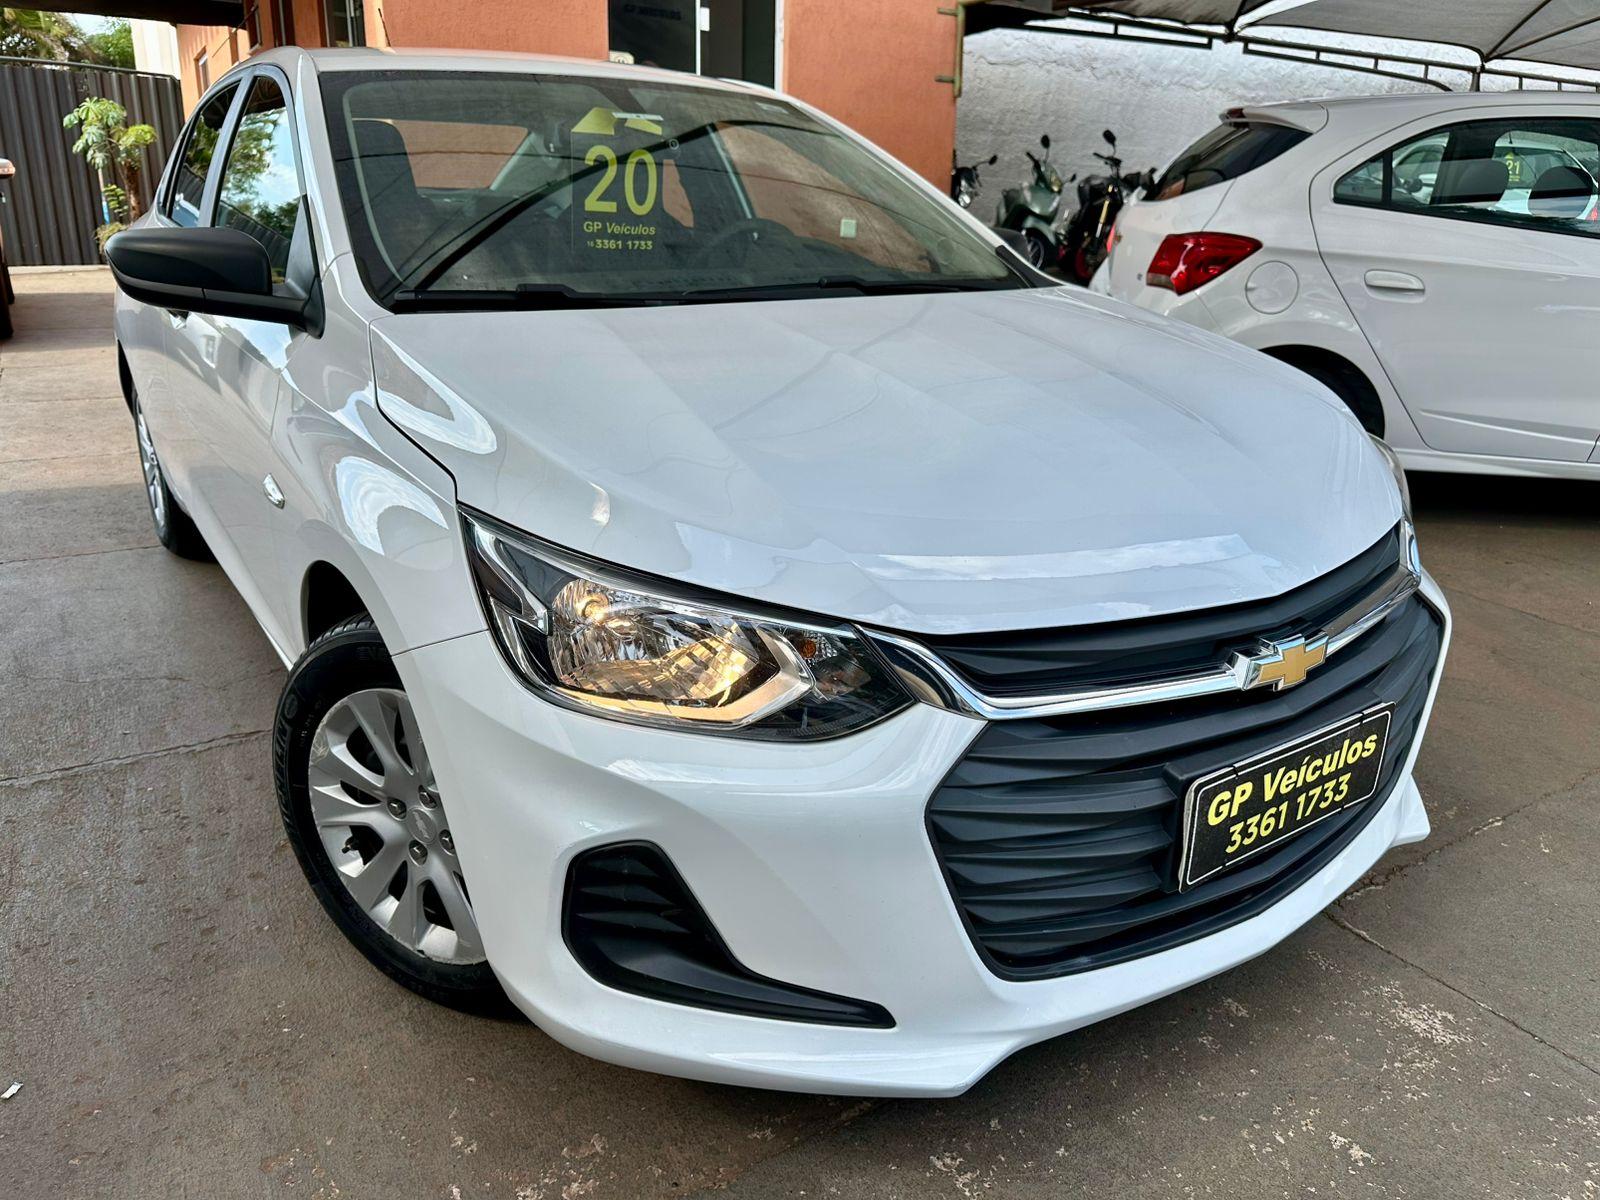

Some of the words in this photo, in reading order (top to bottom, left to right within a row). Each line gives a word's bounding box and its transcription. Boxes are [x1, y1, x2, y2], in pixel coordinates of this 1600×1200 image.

[584, 145, 658, 216] 20
[583, 221, 602, 233] GP
[606, 222, 656, 235] Veículos
[626, 240, 653, 250] 1733
[1207, 781, 1253, 826] GP
[1263, 734, 1378, 802] Veículos
[1225, 800, 1289, 854] 3361
[1296, 772, 1351, 821] 1733
